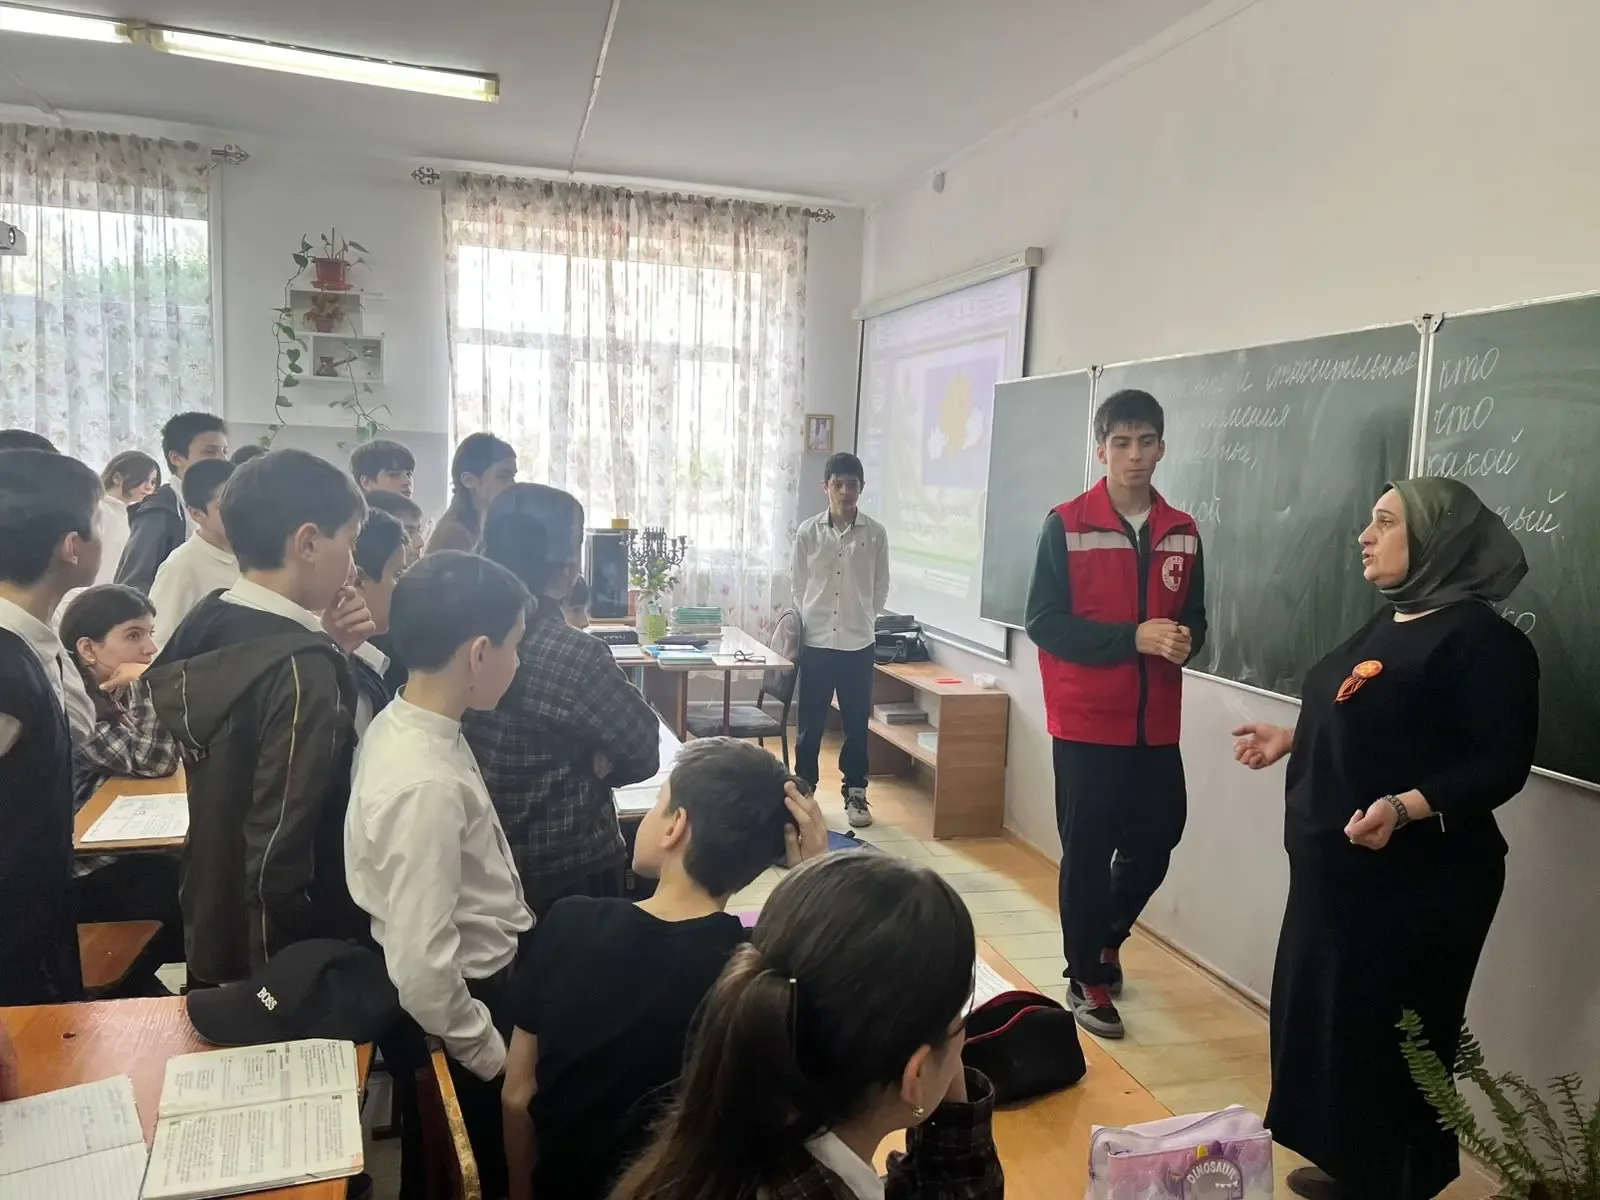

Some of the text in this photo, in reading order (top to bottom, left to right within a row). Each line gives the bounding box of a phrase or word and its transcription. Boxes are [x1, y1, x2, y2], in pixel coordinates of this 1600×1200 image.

[1438, 347, 1499, 392] кто
[1434, 396, 1494, 436] что
[1426, 426, 1521, 478] какой
[256, 986, 278, 1011] BOSS
